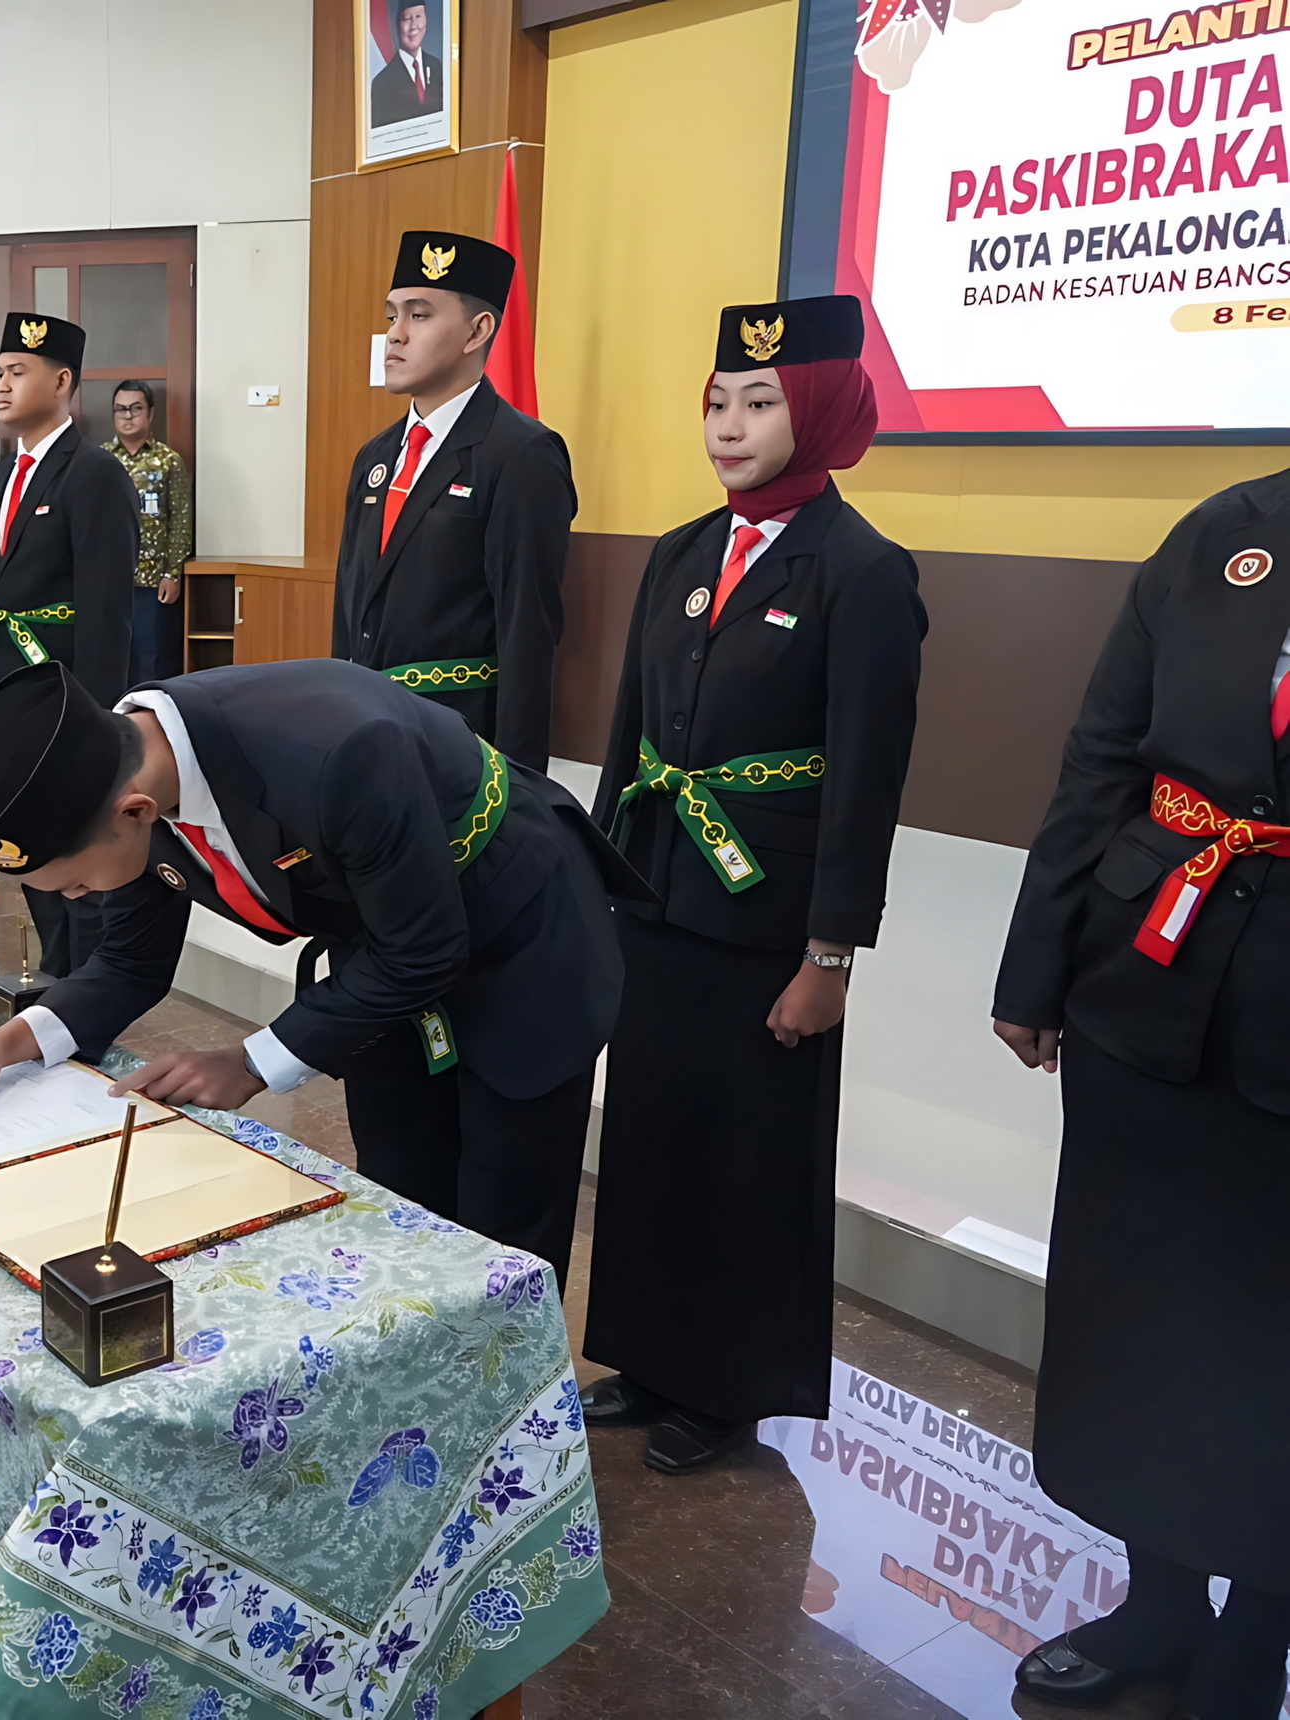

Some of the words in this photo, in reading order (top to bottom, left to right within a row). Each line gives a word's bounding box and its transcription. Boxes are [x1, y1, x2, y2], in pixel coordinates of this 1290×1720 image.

[1067, 0, 1290, 70] PELANTI
[1124, 53, 1283, 135] DUTA
[946, 124, 1290, 222] PASKIBRAKA
[968, 232, 1051, 272] KOTA
[1063, 207, 1290, 264] PEKALONGA
[963, 281, 1044, 306] BADAN
[1052, 269, 1186, 300] KESATUAN
[1195, 260, 1290, 290] BANGS
[1213, 307, 1233, 324] 8
[1246, 304, 1290, 323] Fe
